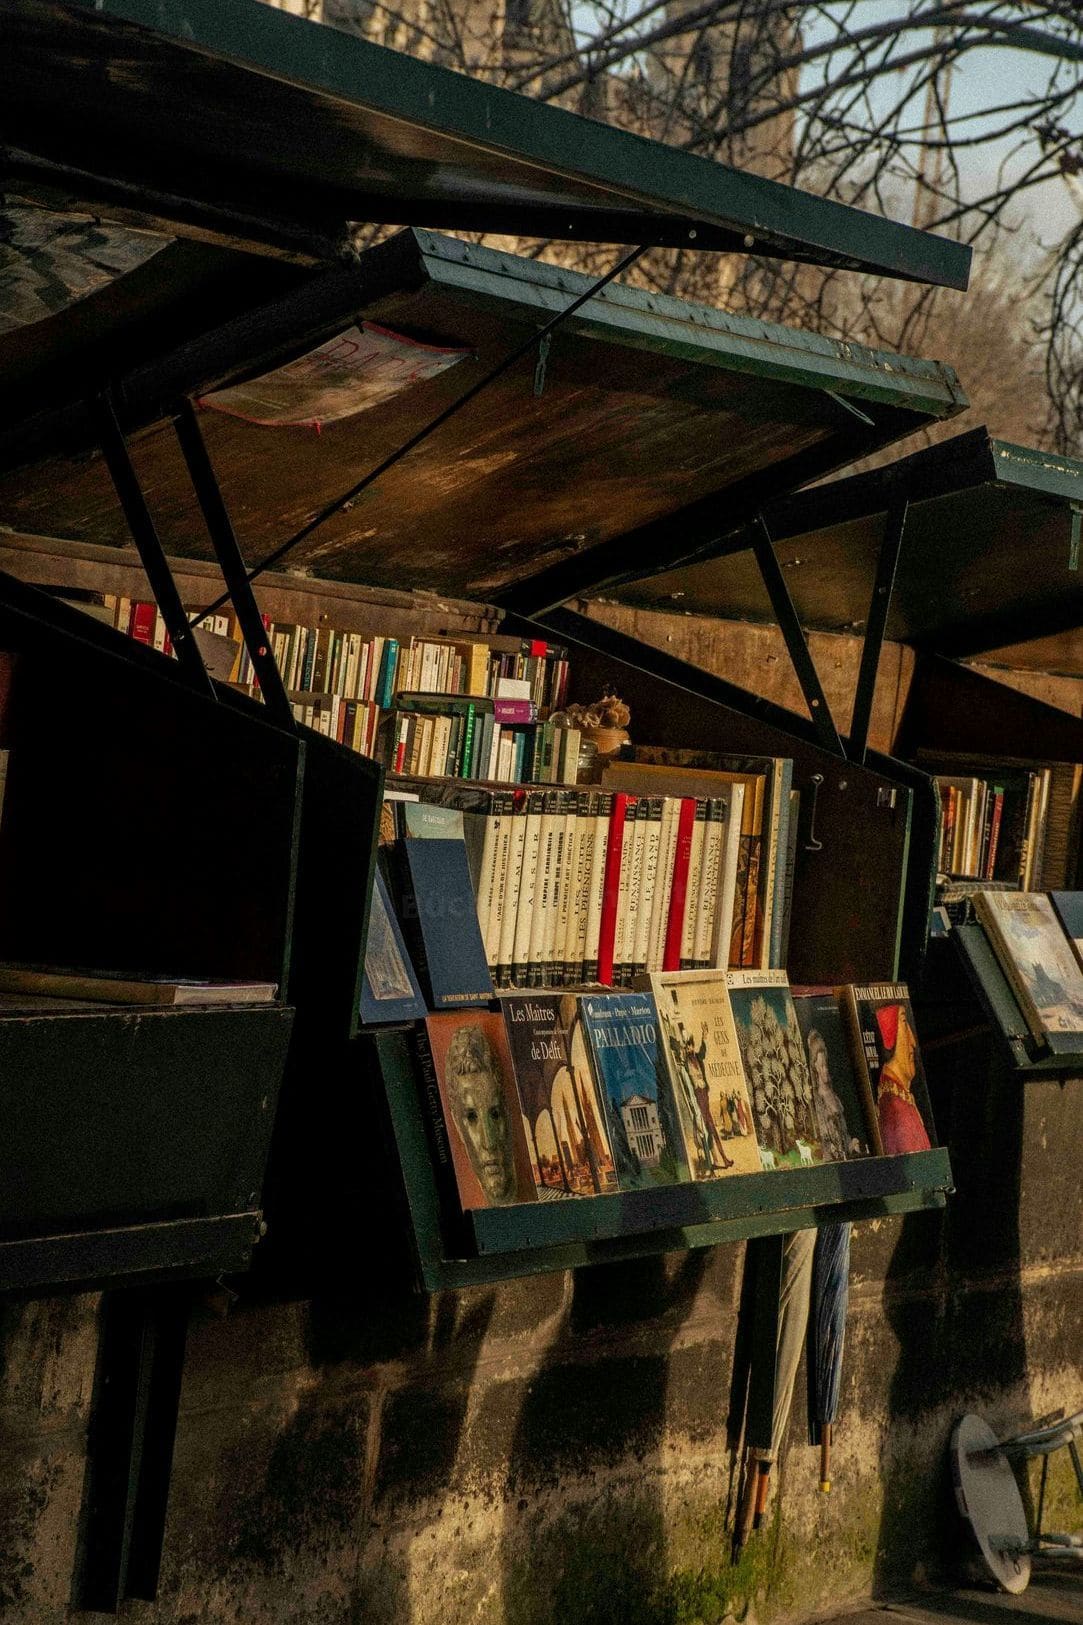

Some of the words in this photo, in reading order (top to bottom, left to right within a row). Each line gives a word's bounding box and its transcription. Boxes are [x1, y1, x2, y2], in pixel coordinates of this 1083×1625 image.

[577, 832, 585, 882] CELTES
[646, 833, 656, 880] GRAND
[500, 872, 505, 880] DE
[512, 832, 523, 907] SUMER
[527, 832, 538, 905] ASSUR
[628, 835, 642, 911] RENAISSANCE
[702, 833, 715, 910] RENAISSANCE
[644, 887, 651, 901] LE
[578, 917, 586, 939] LES
[509, 1003, 525, 1021] Les
[524, 1003, 555, 1021] Maîtres
[714, 1015, 724, 1026] LES
[593, 1024, 656, 1049] PALLADIO
[714, 1030, 730, 1045] GENS
[531, 1041, 541, 1060] de
[540, 1040, 562, 1060] Delft
[708, 1061, 740, 1077] MÉDECINE
